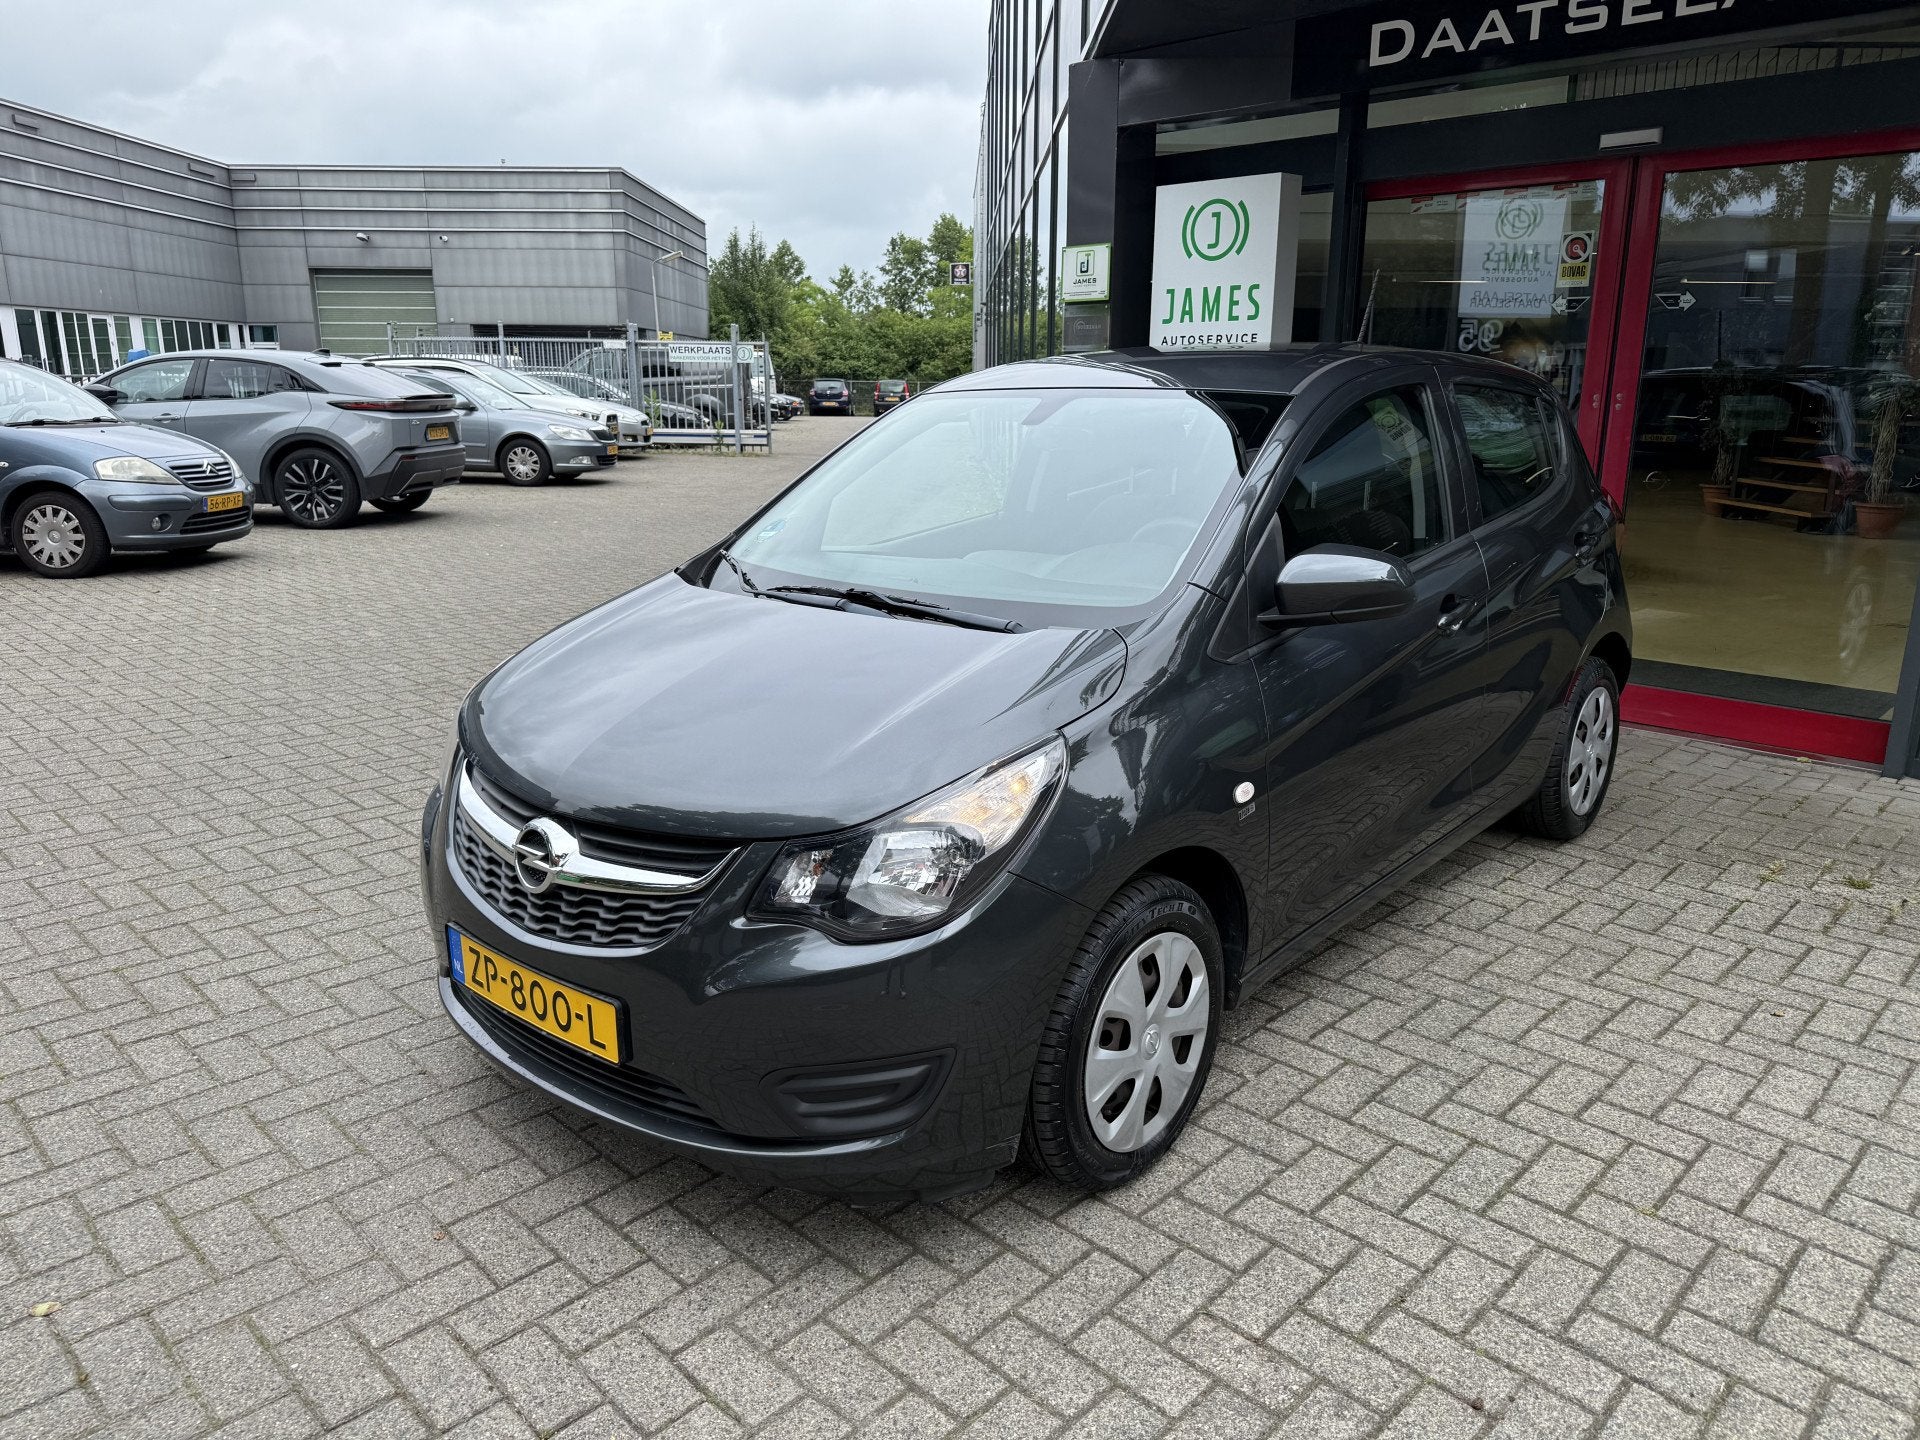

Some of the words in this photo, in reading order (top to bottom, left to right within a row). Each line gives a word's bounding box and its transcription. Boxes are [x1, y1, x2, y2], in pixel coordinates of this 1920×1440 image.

[1368, 0, 1735, 68] DAATSEL
[1561, 265, 1586, 278] BOVAG
[1073, 277, 1097, 285] JAMES
[1161, 284, 1260, 325] JAMES
[1161, 333, 1258, 346] AUTOSERVICE
[669, 346, 731, 355] WERKPLAATS
[453, 958, 464, 974] NL
[468, 945, 607, 1051] ZP-800-L
